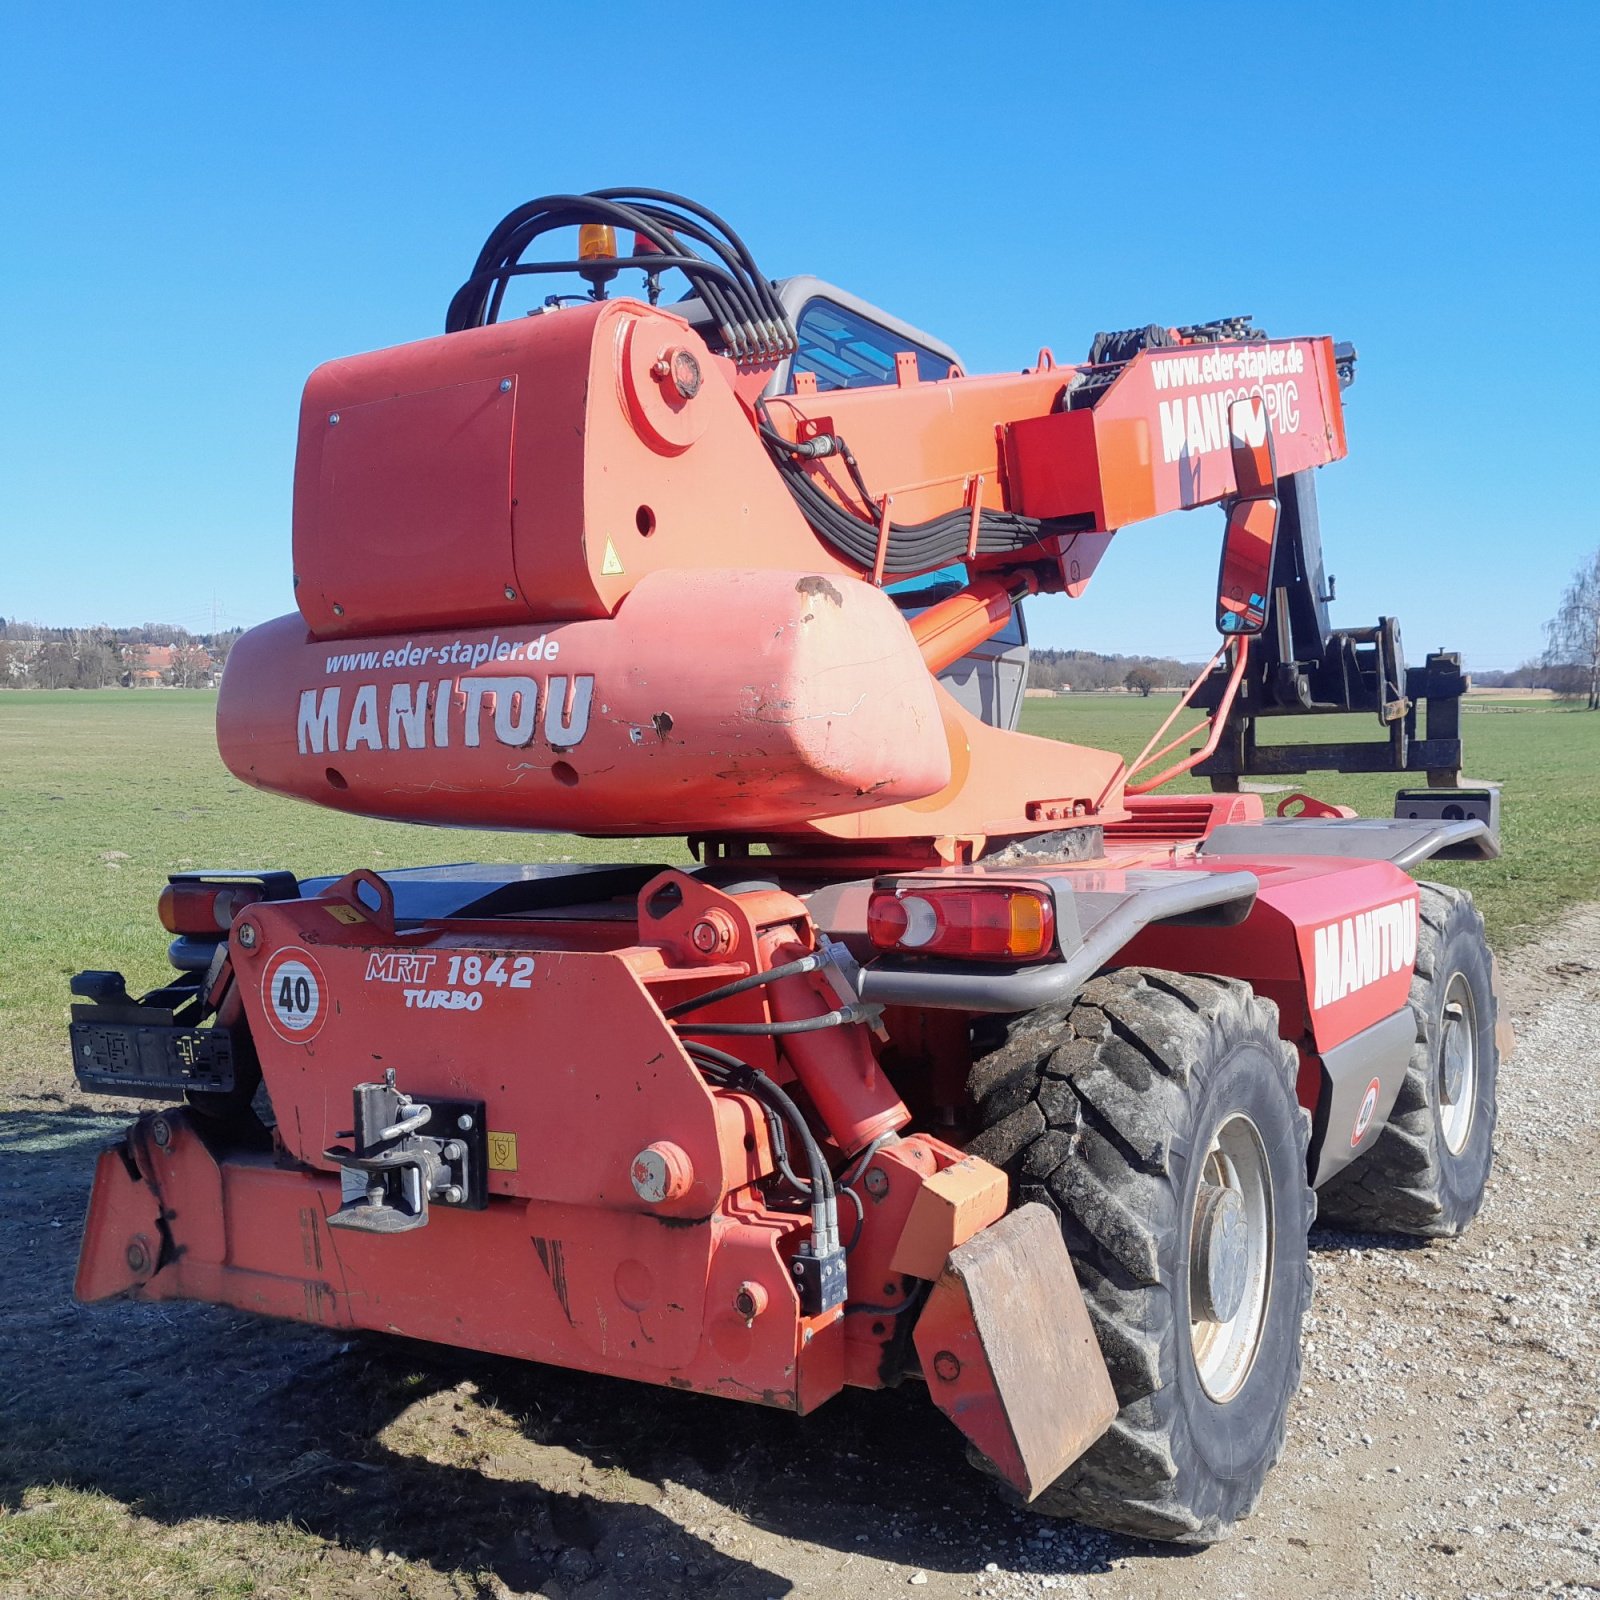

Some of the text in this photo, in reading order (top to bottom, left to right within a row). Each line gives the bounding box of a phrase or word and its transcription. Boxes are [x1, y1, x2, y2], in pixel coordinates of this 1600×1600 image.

[1151, 342, 1304, 390] www.eder-stapler.de
[325, 634, 560, 674] www.eder-stapler.de
[297, 675, 595, 754] MANITOU
[364, 953, 536, 989] MRT 1842
[1314, 898, 1417, 1010] MANITOU
[279, 976, 311, 1013] 40
[403, 989, 483, 1012] TURBO
